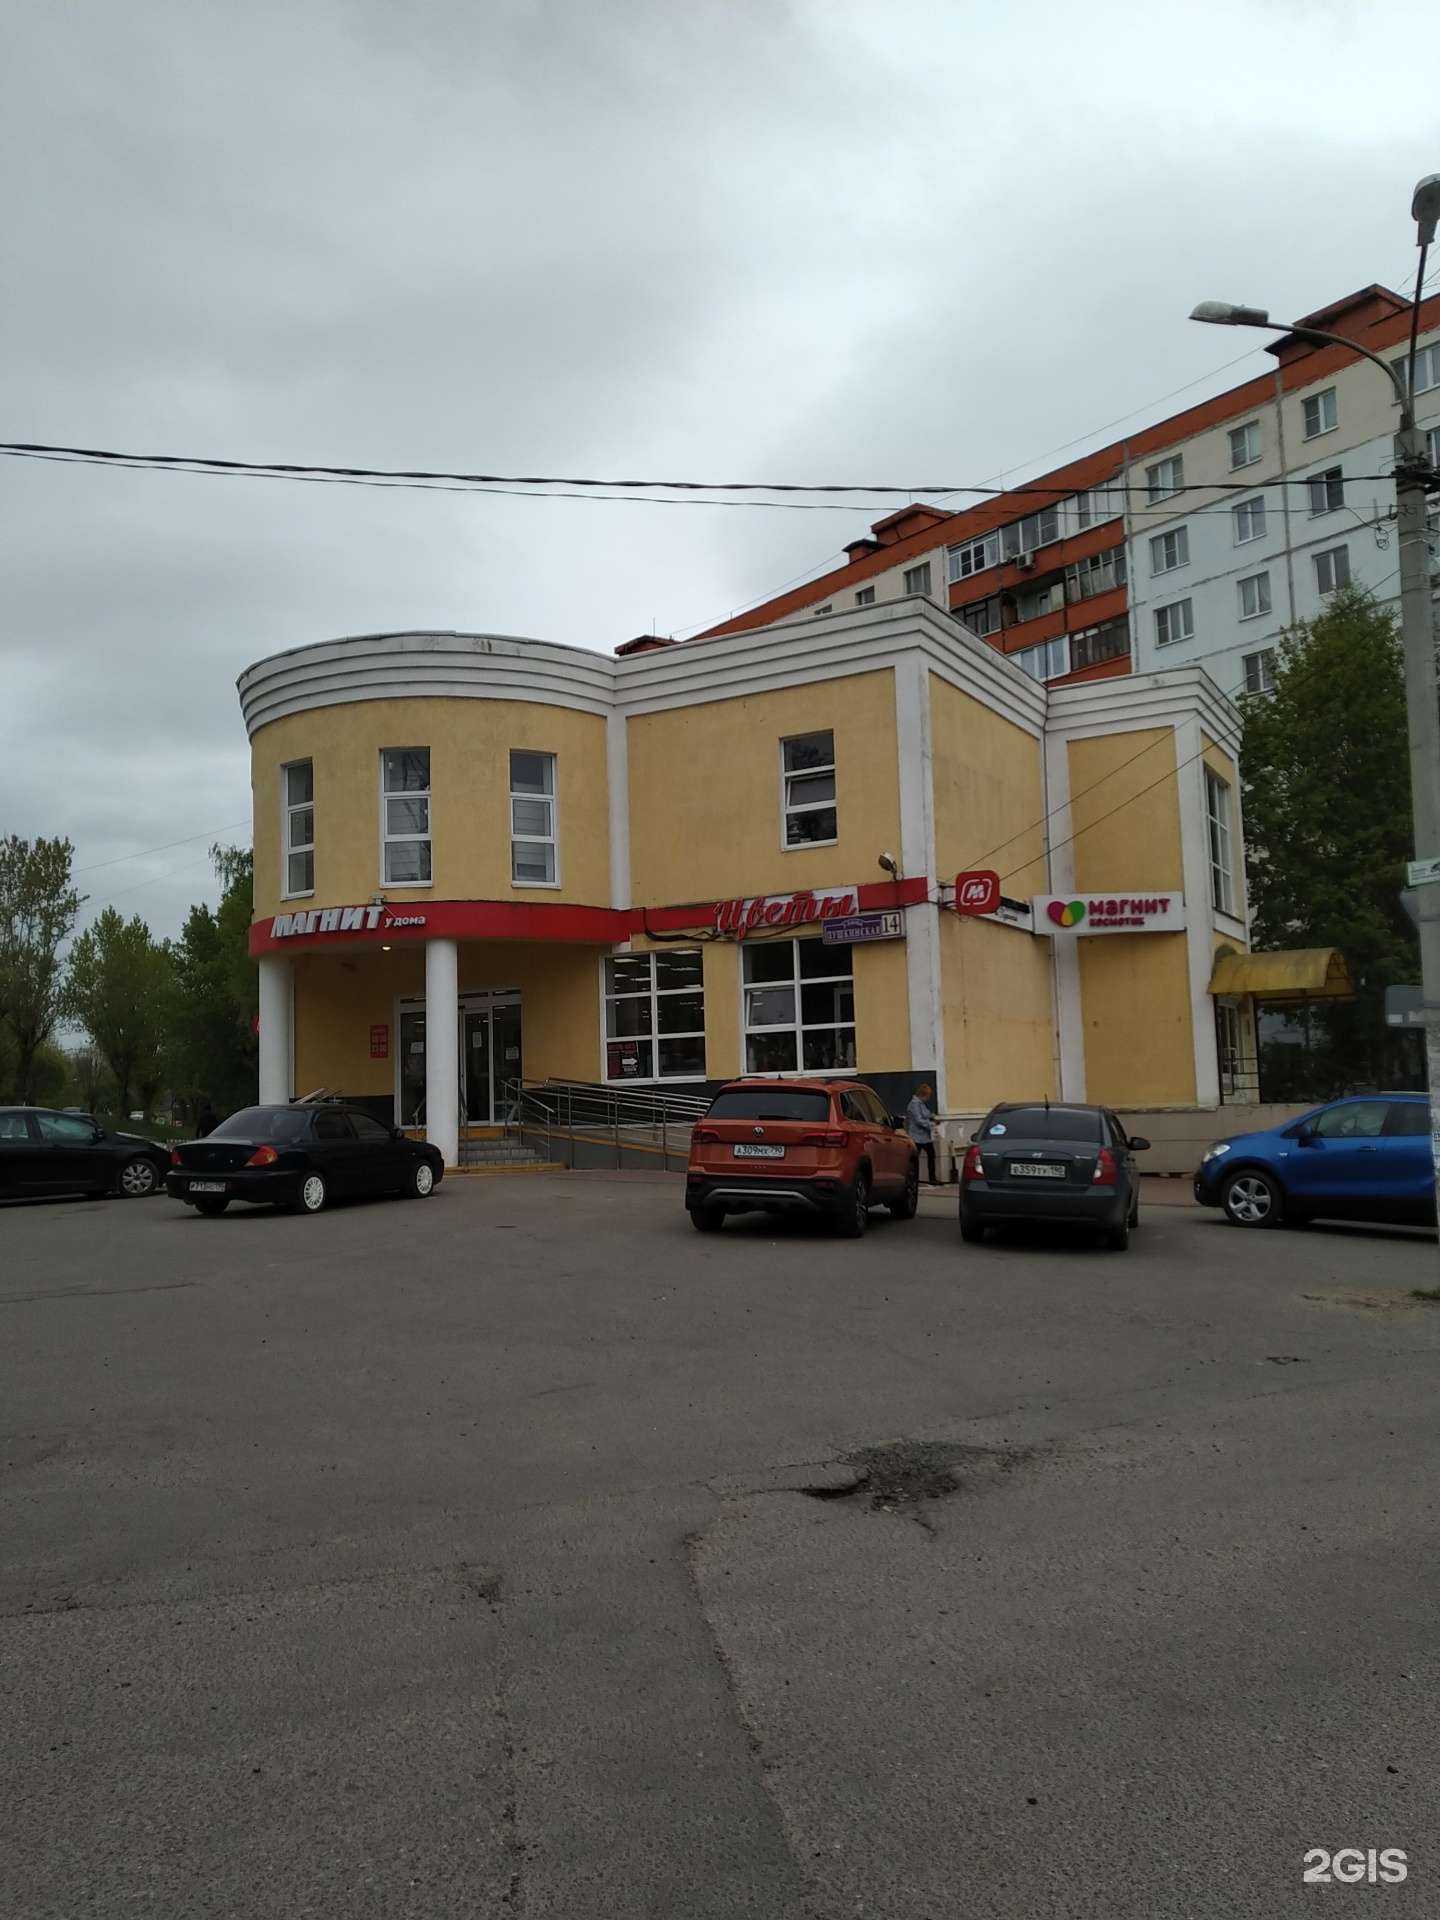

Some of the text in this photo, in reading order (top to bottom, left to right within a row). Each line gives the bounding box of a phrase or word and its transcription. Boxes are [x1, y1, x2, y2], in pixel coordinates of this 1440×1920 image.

[270, 905, 384, 938] МАГНИТ
[393, 916, 426, 926] дома
[713, 890, 857, 940] Цветы
[883, 915, 899, 933] 14
